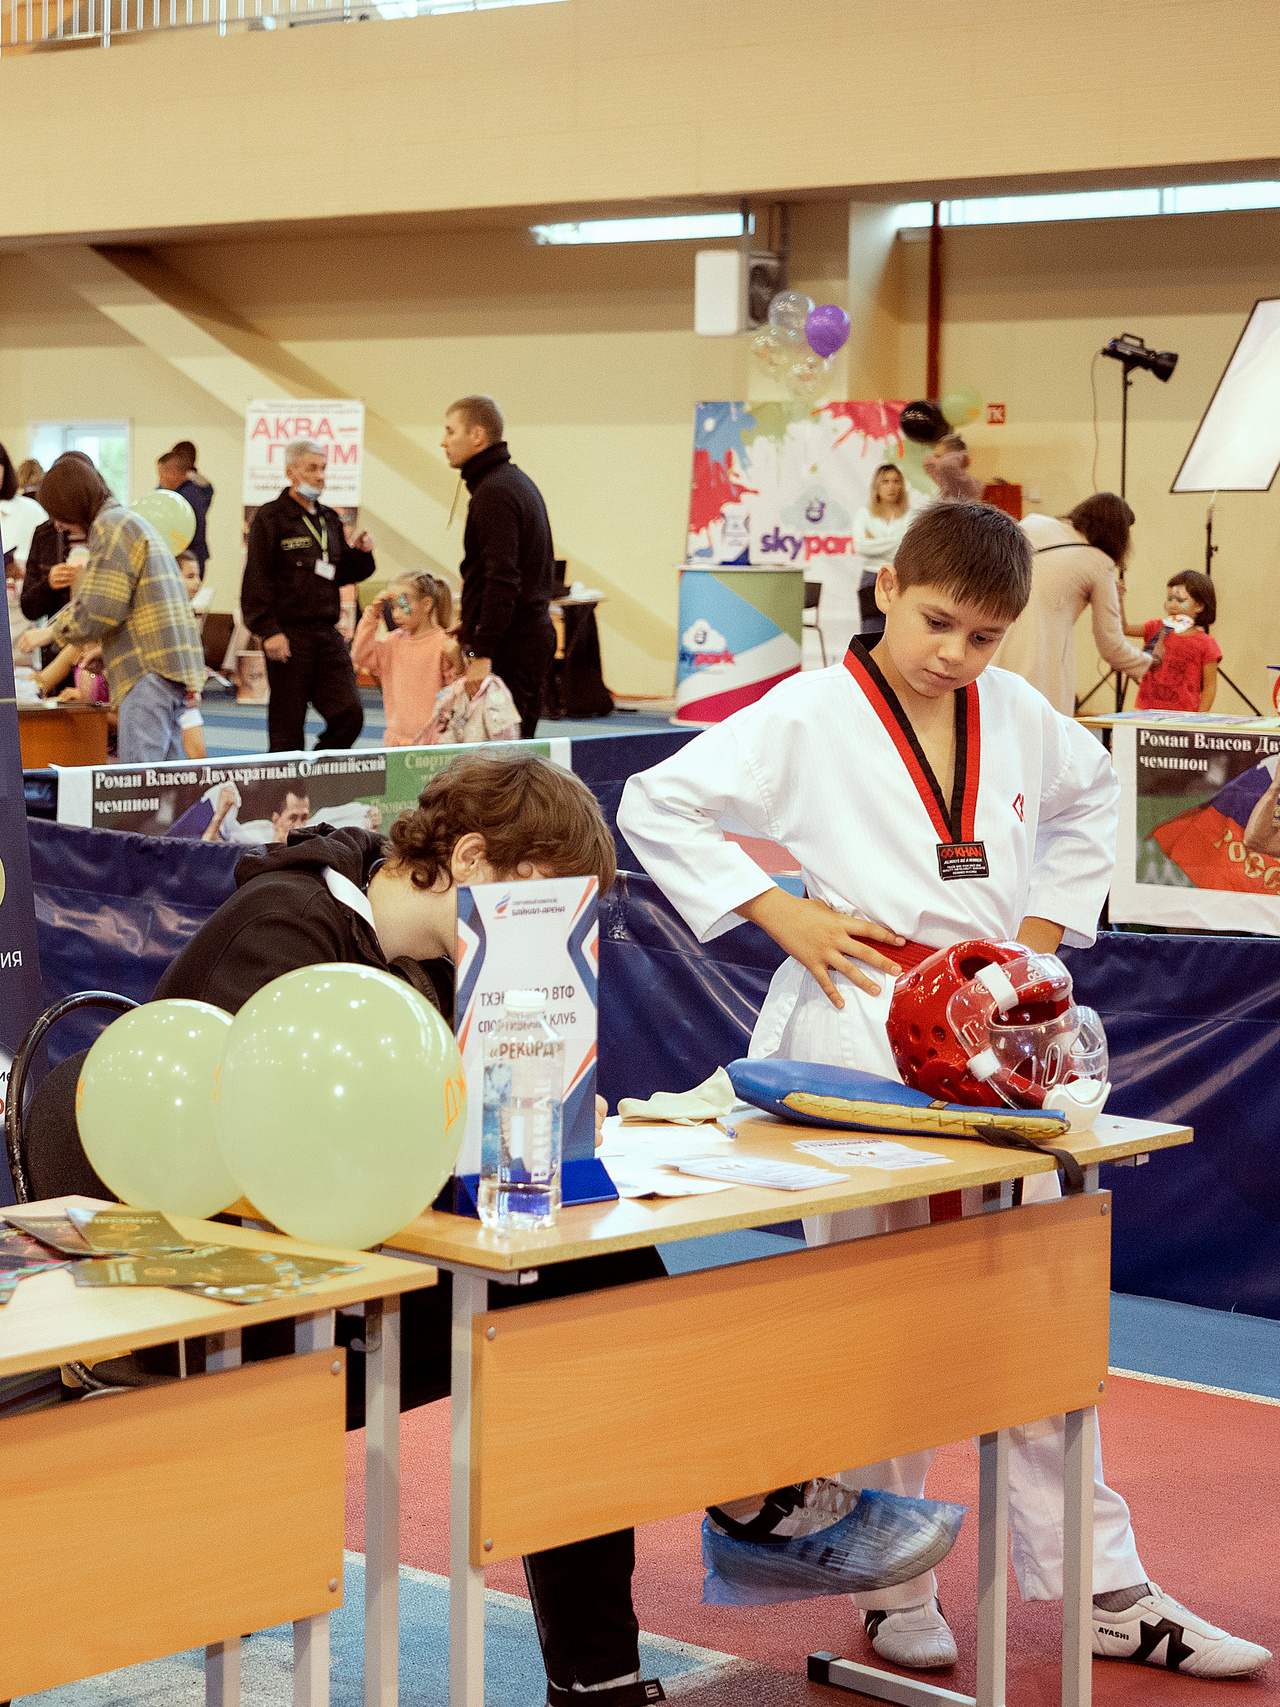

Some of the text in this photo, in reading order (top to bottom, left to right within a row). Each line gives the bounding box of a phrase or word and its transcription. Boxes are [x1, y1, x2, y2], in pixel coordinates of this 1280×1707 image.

[1139, 729, 1189, 750] Роман
[1194, 732, 1252, 753] Власов
[1139, 754, 1208, 773] чемпион
[94, 767, 142, 790] Роман
[145, 766, 198, 787] Власов
[94, 796, 160, 815] чемпион
[954, 846, 982, 857] KHAN
[511, 906, 566, 916] БАЙКАЛ-АРЕНА
[552, 985, 576, 1000] ВТФ
[549, 1011, 577, 1026] КЛУБ
[1098, 1627, 1129, 1640] AYASHI
